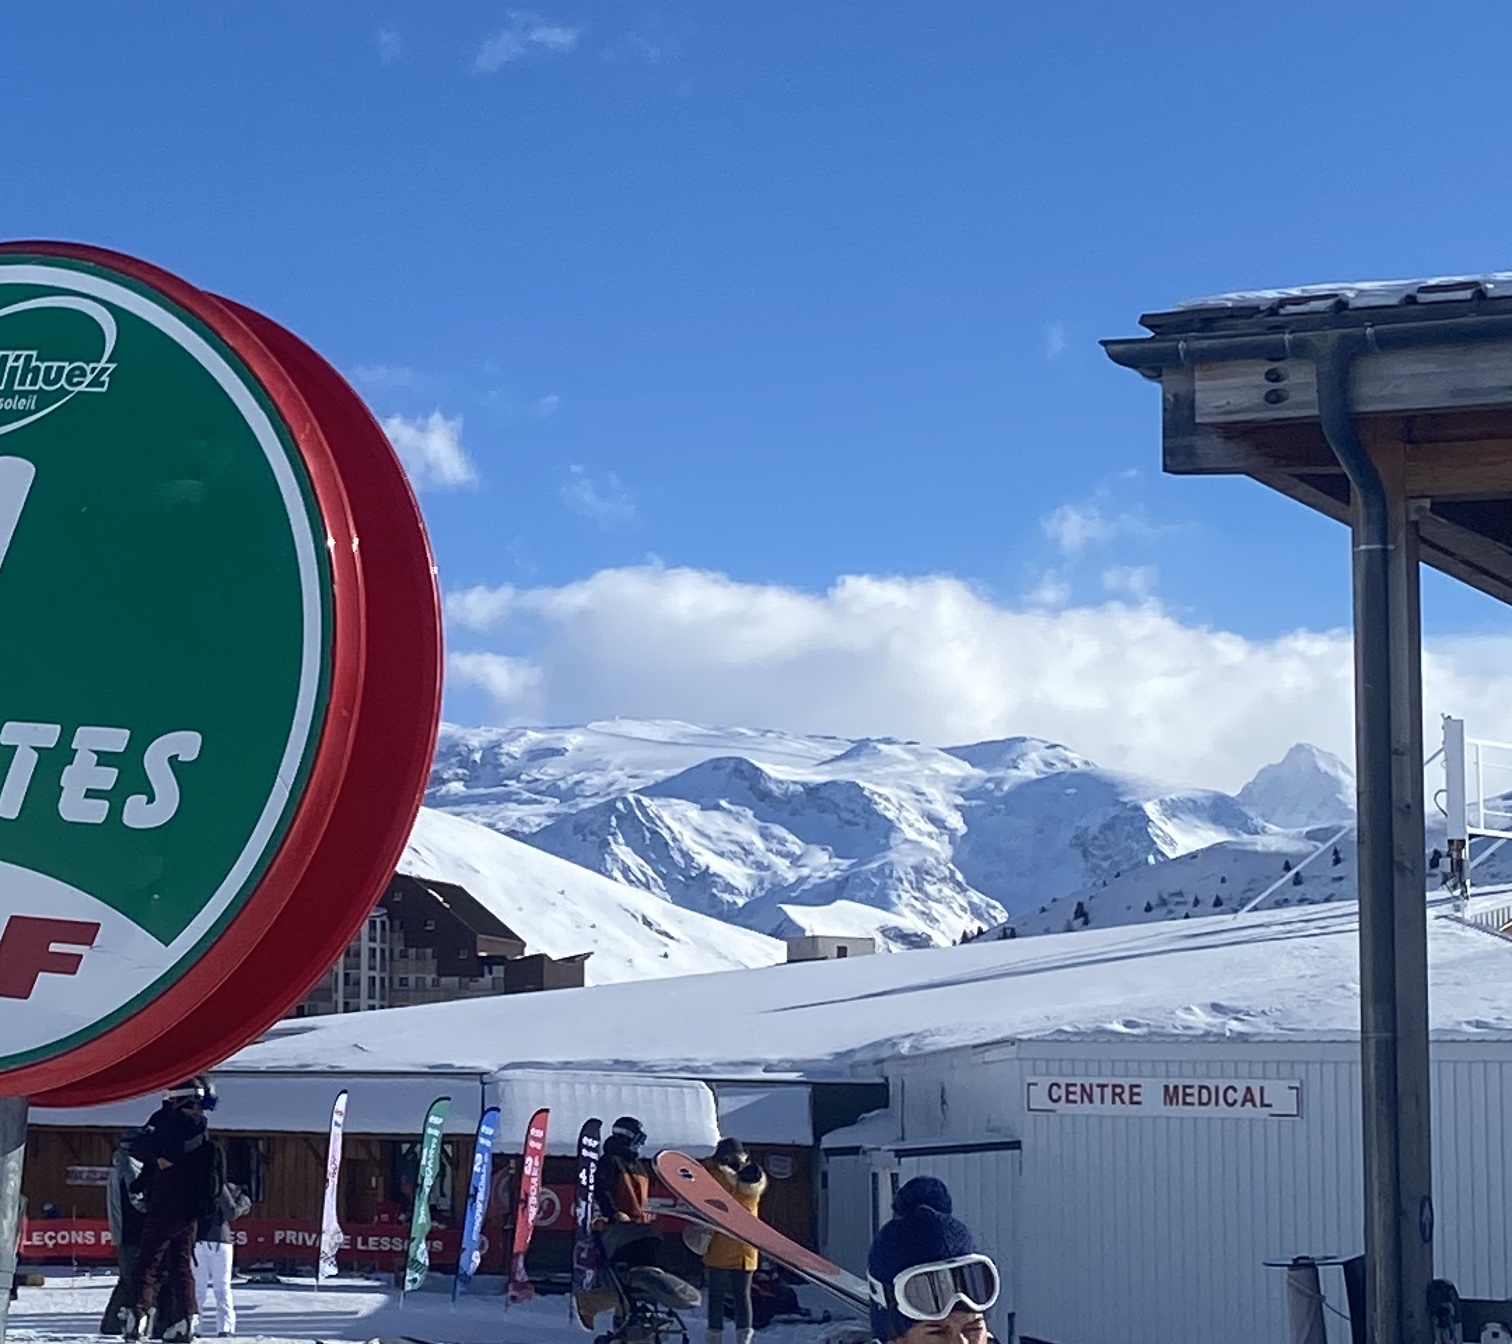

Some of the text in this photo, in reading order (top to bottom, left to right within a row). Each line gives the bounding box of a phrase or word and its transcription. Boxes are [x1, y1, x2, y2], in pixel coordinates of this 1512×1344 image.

[1047, 1082, 1273, 1108] CENTRE MEDICAL
[274, 1230, 351, 1249] PRIVE
[357, 1236, 443, 1251] LESSS
